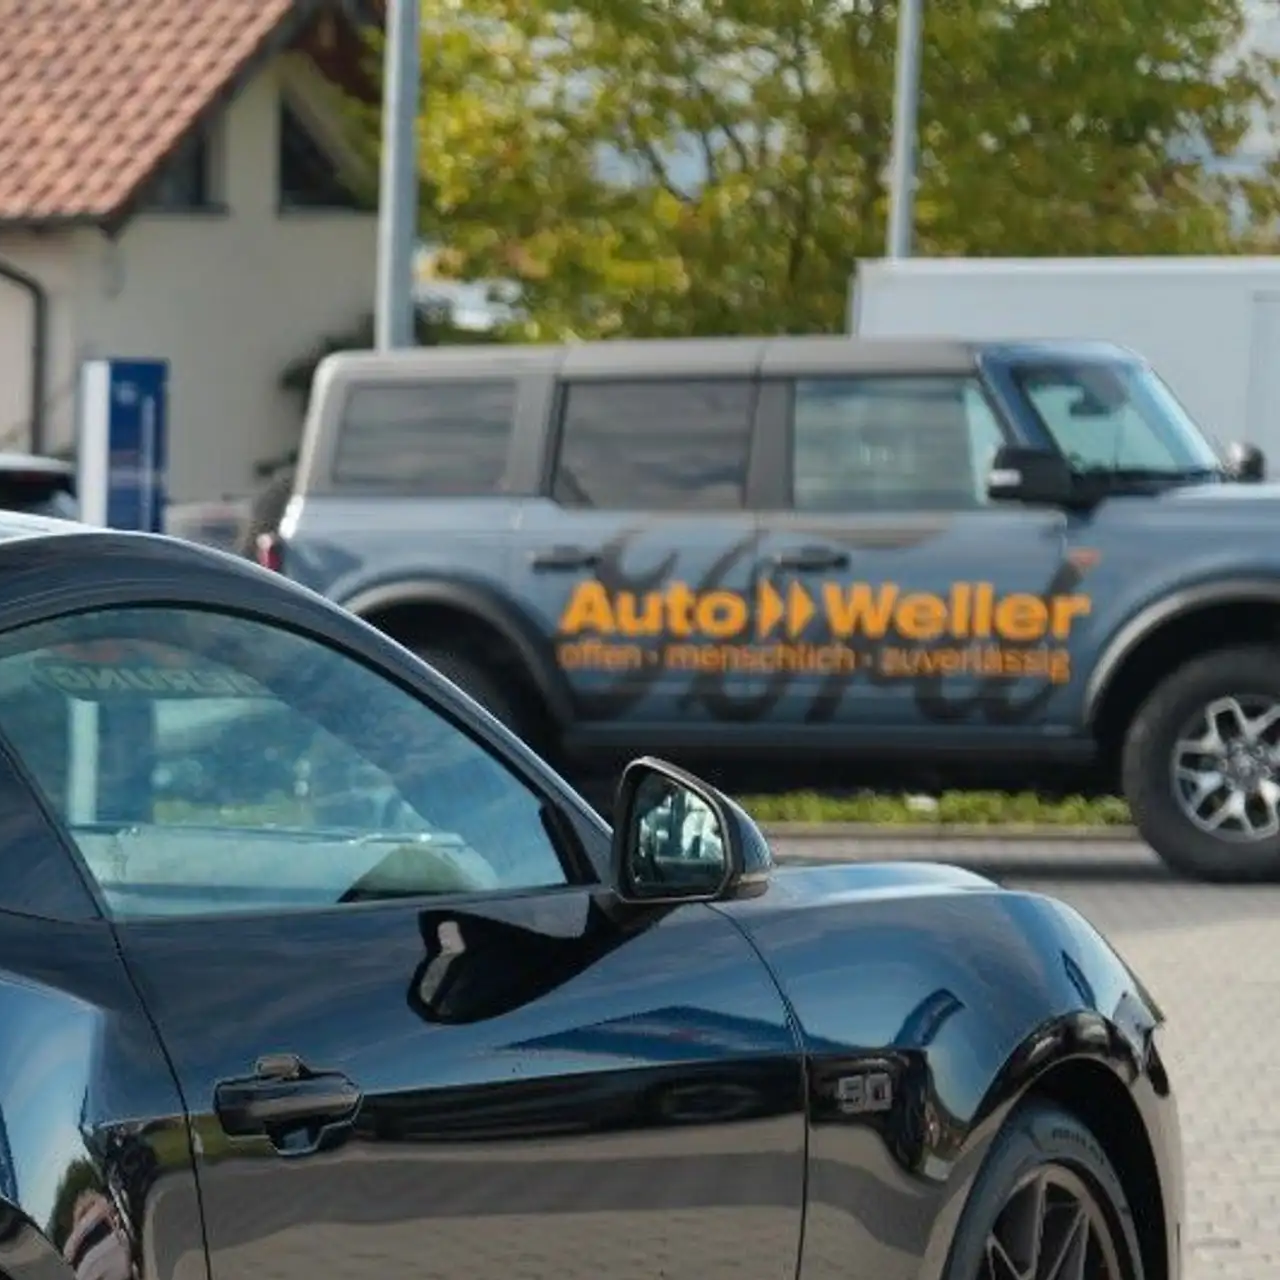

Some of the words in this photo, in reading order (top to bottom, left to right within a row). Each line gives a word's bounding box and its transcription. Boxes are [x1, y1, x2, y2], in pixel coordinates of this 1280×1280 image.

[557, 579, 748, 639] Auto
[820, 580, 1091, 641] Weller
[559, 641, 641, 672] offen
[665, 641, 856, 673] menschlich
